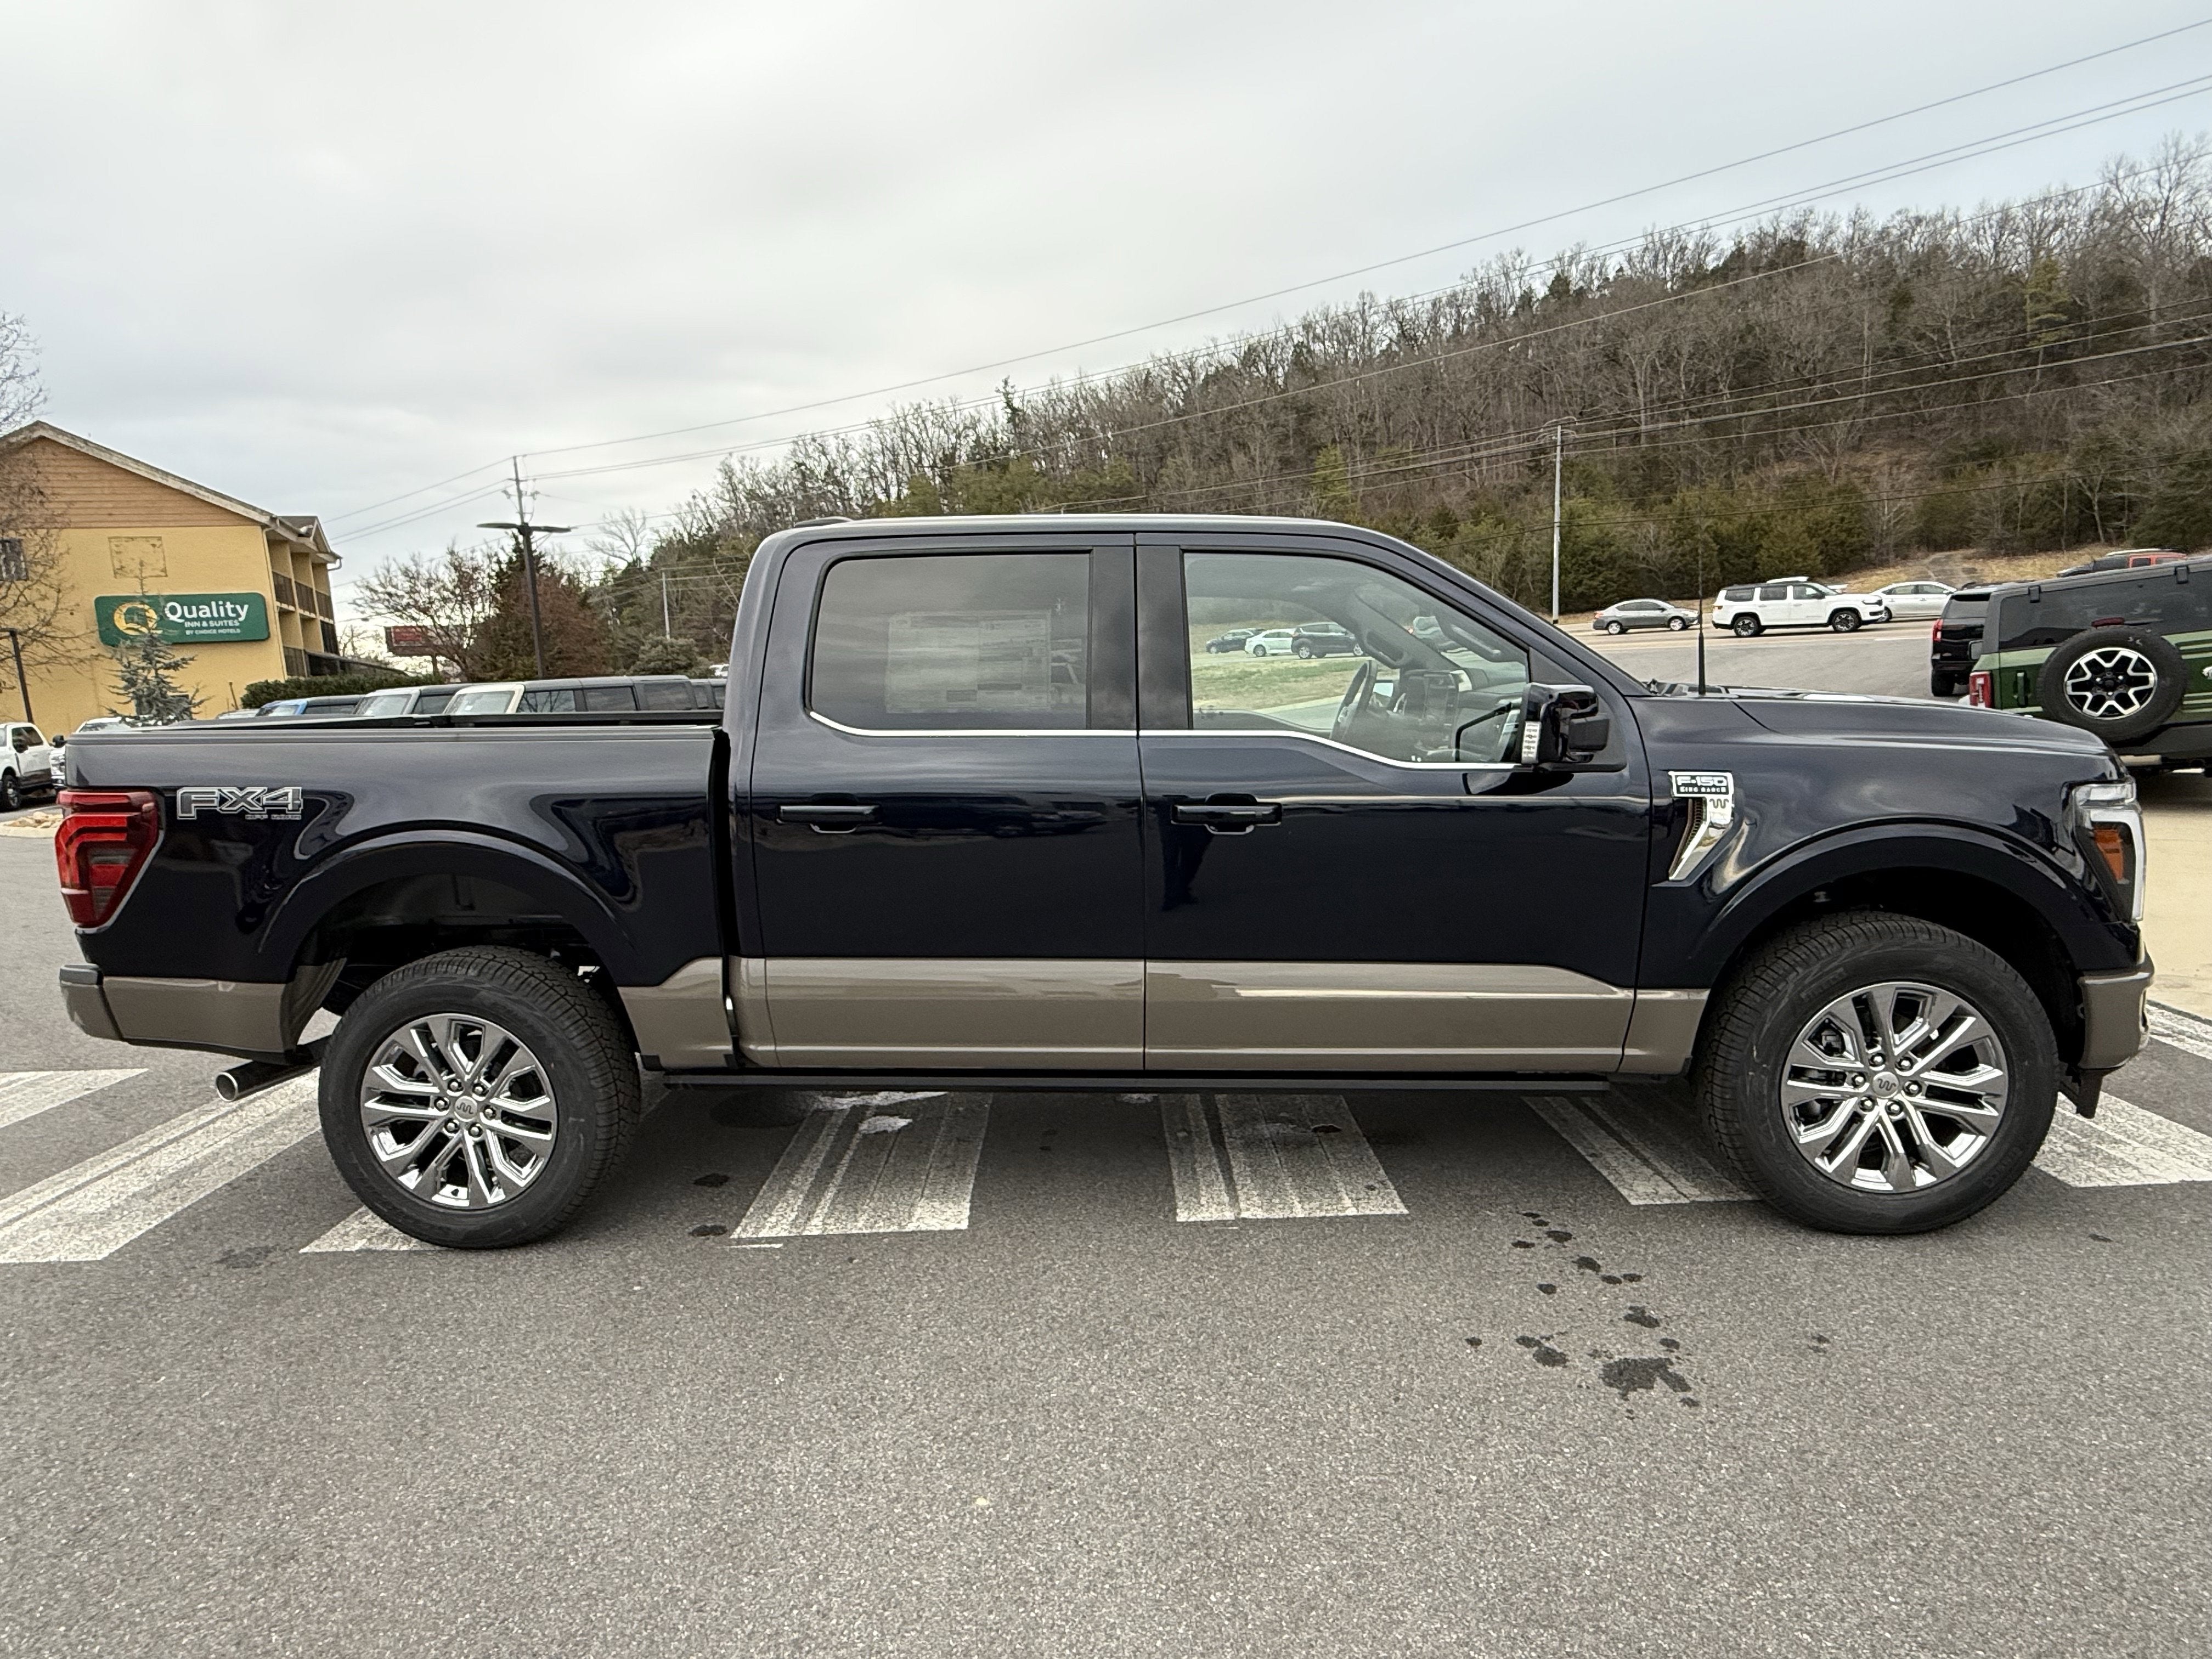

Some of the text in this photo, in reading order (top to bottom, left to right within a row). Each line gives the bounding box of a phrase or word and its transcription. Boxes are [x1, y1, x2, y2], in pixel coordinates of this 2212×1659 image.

[165, 600, 249, 623] Quality
[1677, 776, 1728, 786] F-150
[177, 787, 304, 820] FX4
